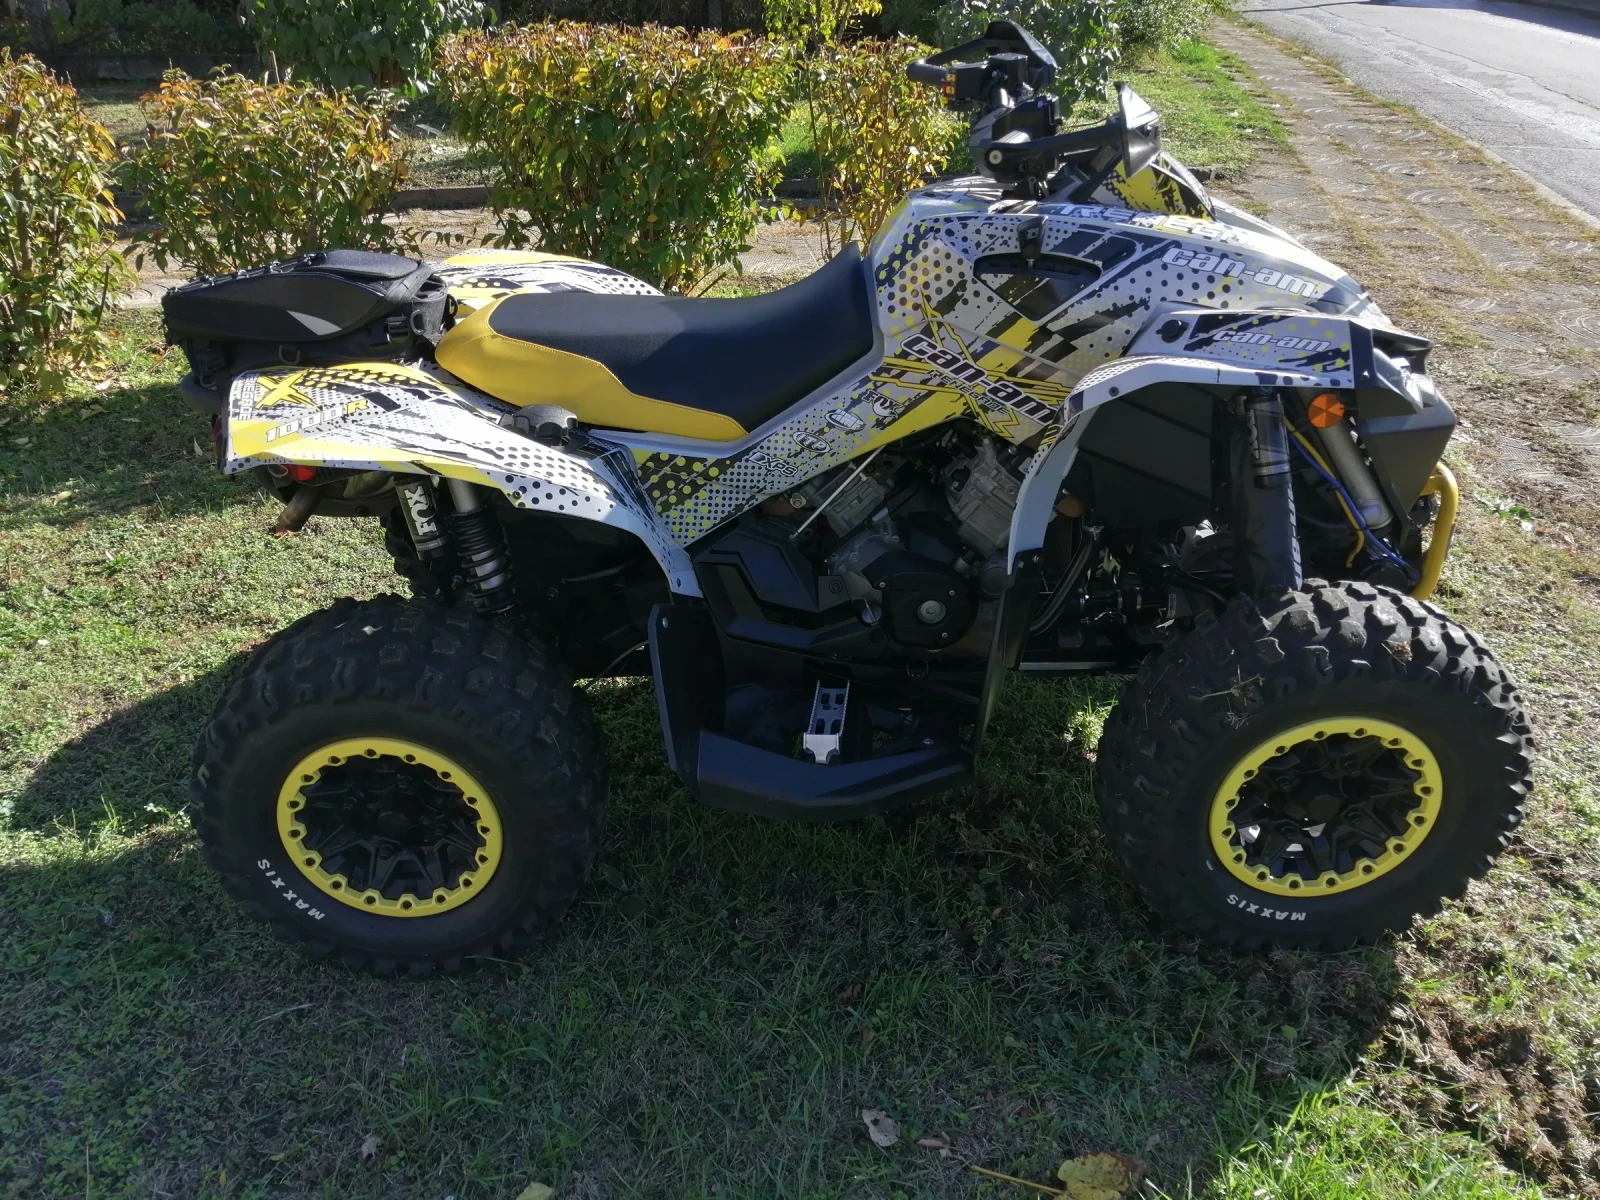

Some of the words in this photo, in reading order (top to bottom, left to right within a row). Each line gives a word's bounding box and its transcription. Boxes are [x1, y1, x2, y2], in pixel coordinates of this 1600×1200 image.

[1060, 204, 1257, 248] RENEGA
[1161, 247, 1317, 299] can-am
[1212, 330, 1331, 352] can-am
[861, 389, 904, 413] FOX
[901, 334, 1059, 426] can-am
[927, 370, 1010, 414] RENEGADE
[404, 485, 438, 536] FOX
[258, 858, 326, 921] MAXXIS
[1226, 893, 1307, 921] MAXXIS
